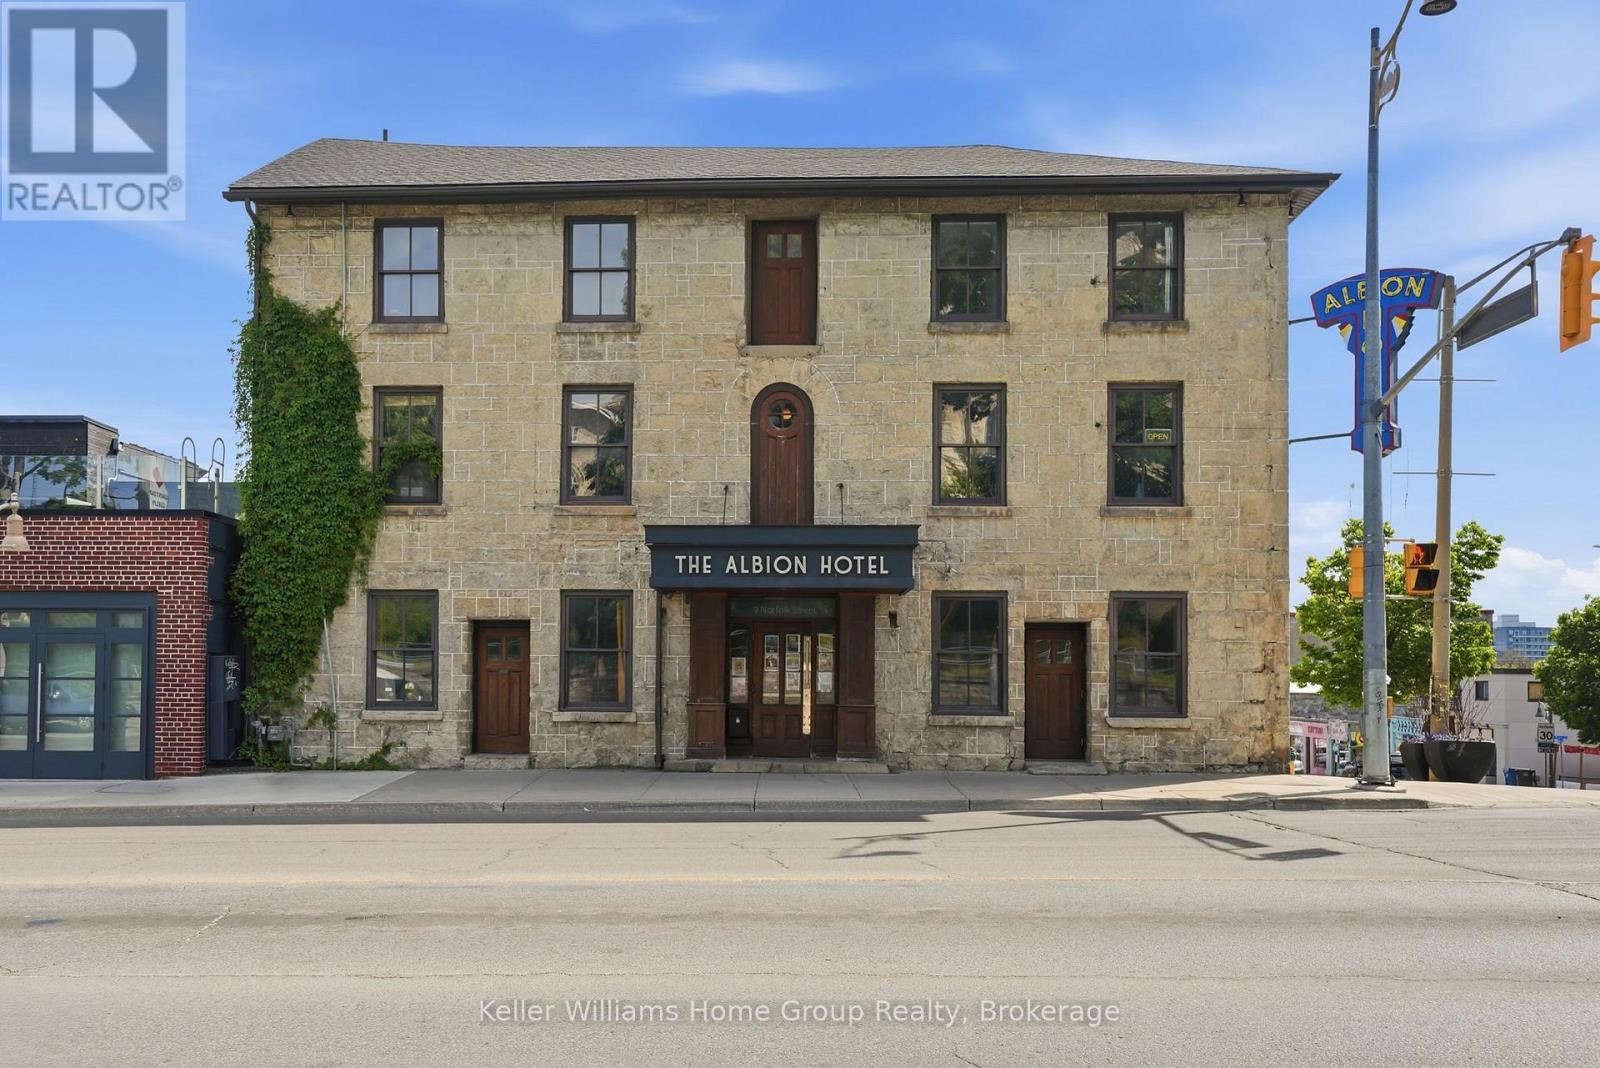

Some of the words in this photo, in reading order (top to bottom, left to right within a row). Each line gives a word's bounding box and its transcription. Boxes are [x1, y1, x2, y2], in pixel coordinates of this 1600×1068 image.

[1324, 275, 1427, 314] ALBON
[1146, 432, 1169, 441] OPEN
[675, 555, 712, 574] THE
[725, 555, 807, 575] ALBION
[820, 555, 889, 575] HOTEL
[1539, 731, 1553, 741] 30
